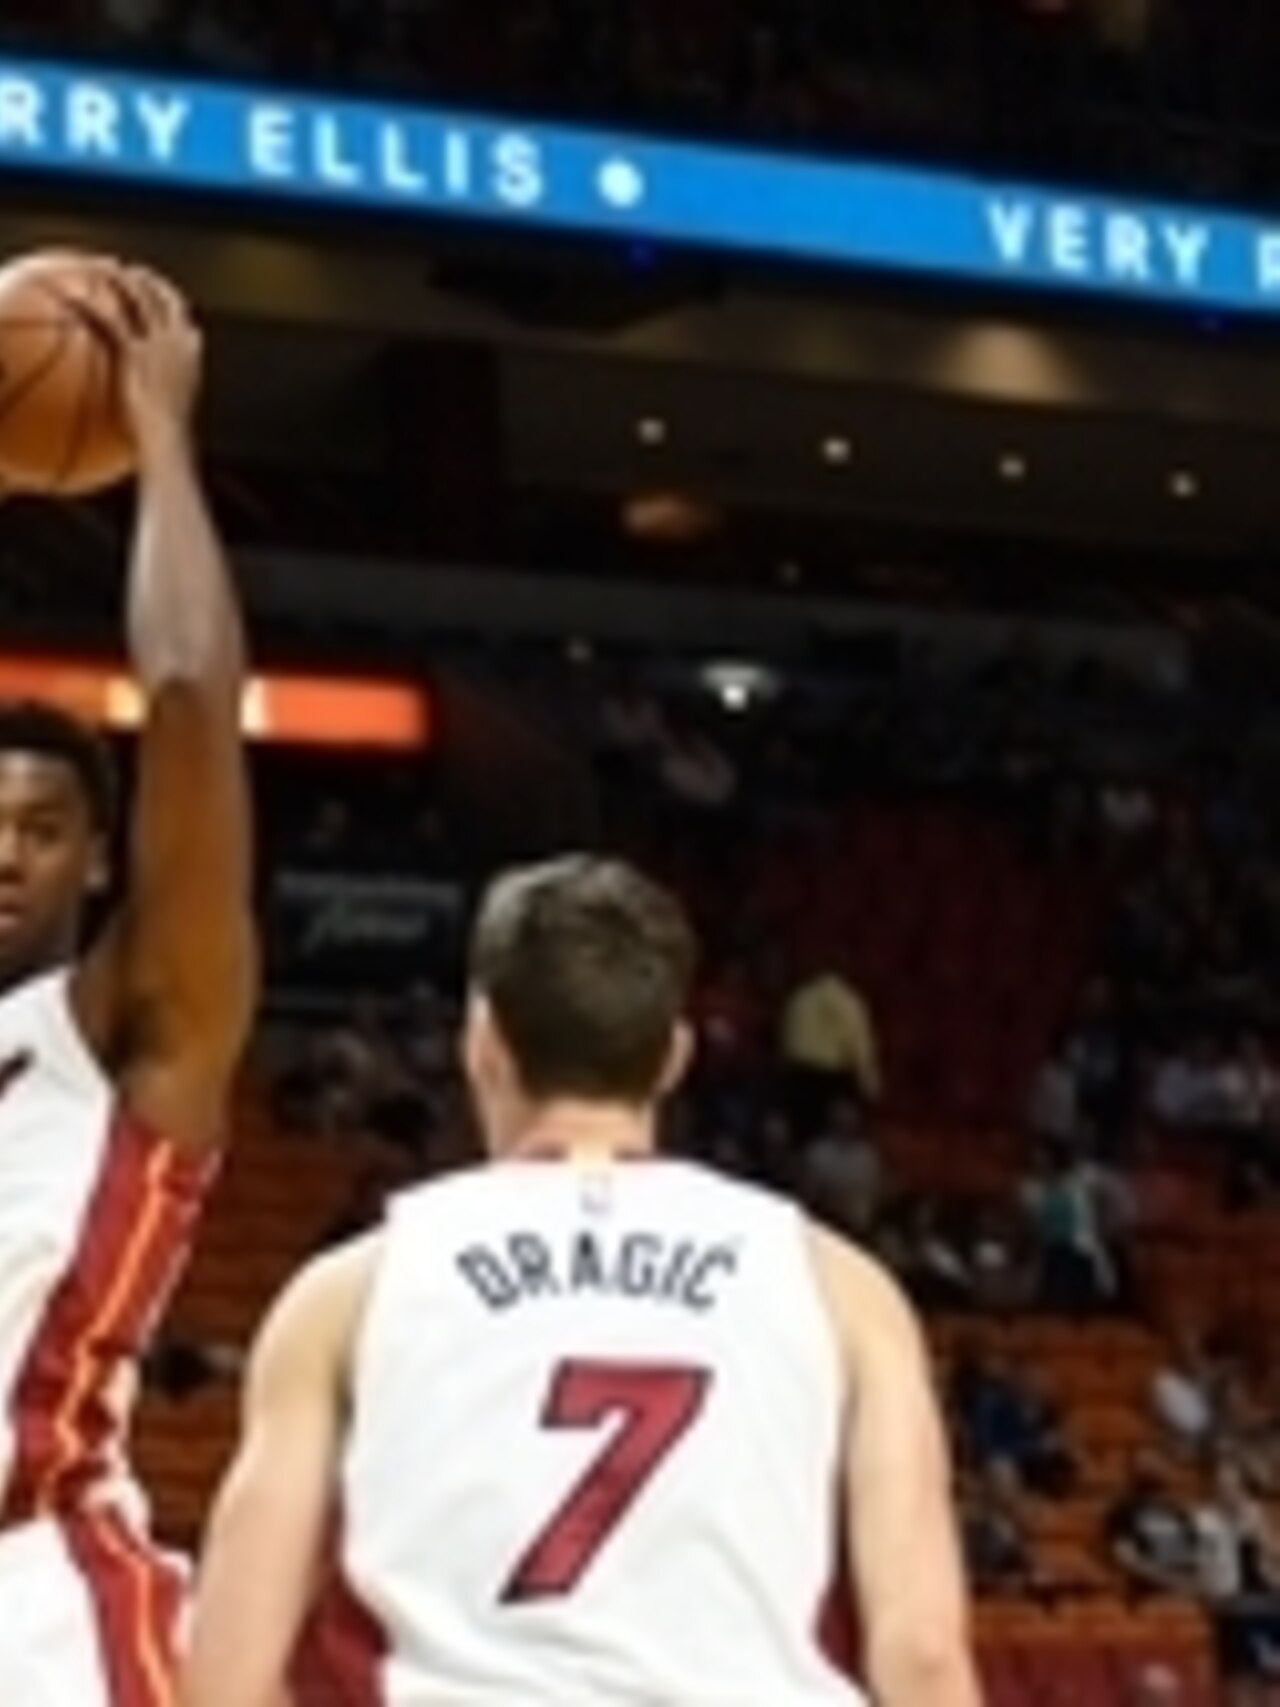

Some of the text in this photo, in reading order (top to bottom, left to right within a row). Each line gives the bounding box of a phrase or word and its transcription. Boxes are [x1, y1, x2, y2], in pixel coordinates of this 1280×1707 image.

[248, 105, 542, 207] ELLIS
[987, 202, 1210, 282] VERY
[497, 1357, 713, 1607] 7
